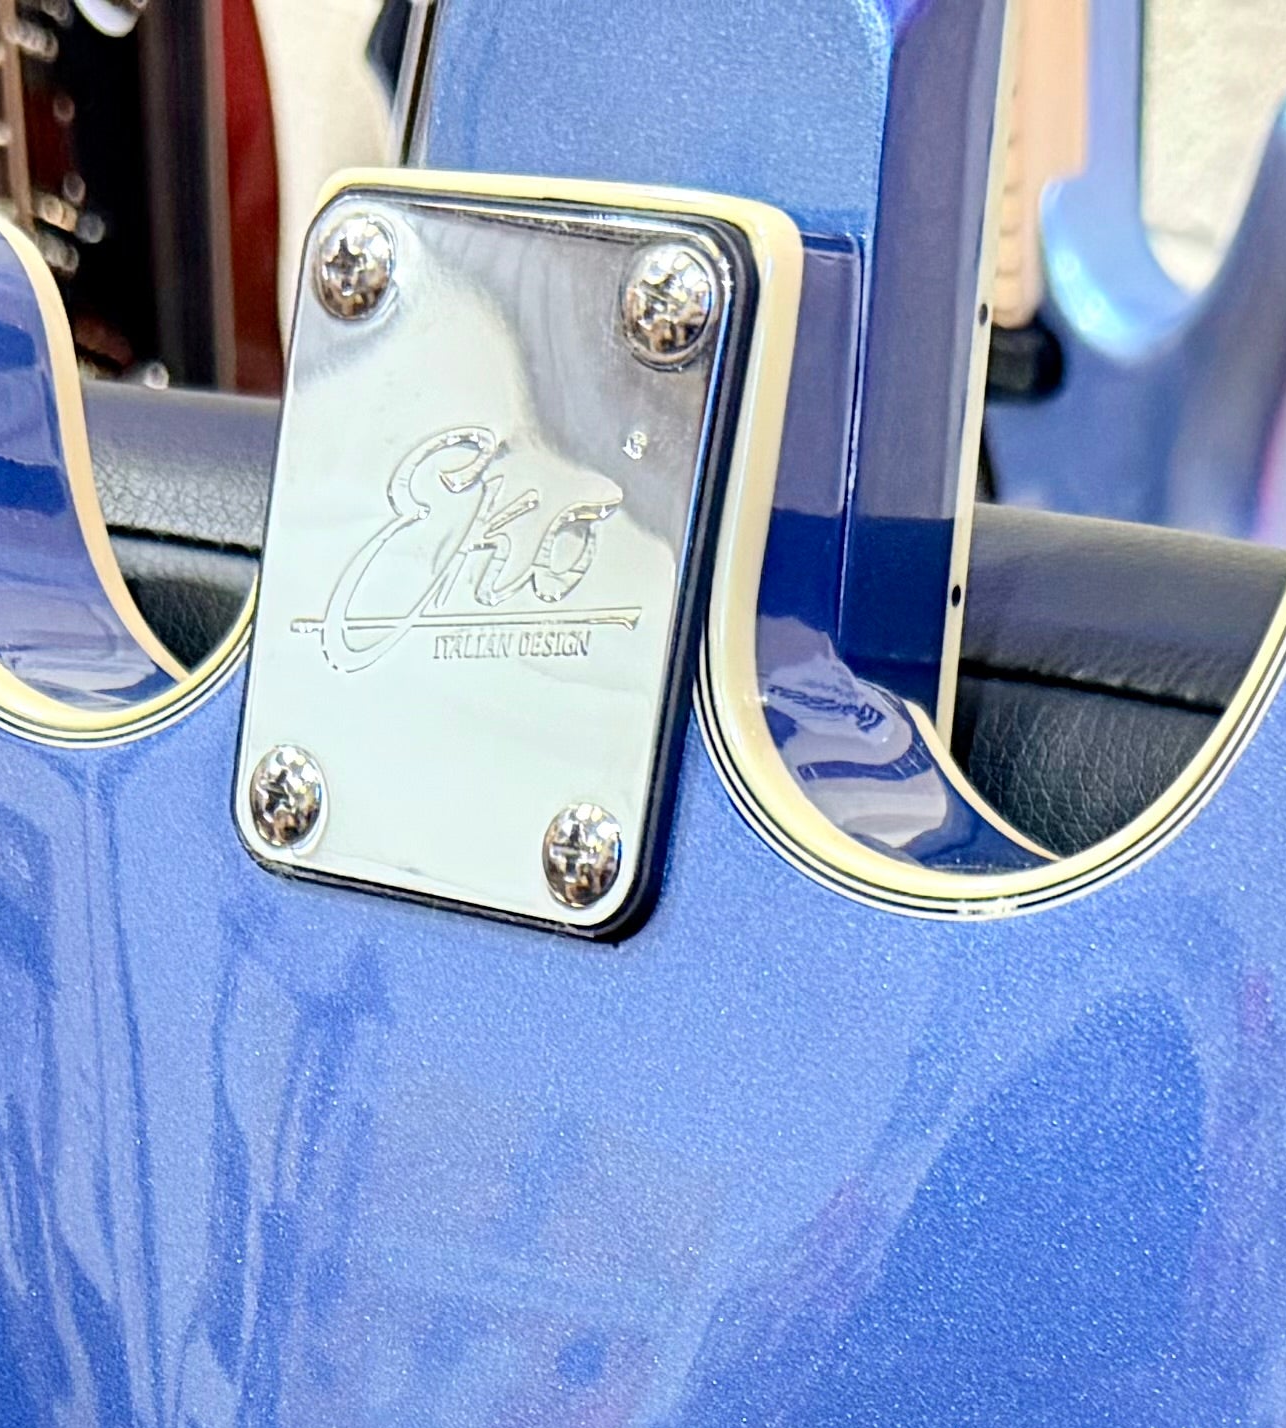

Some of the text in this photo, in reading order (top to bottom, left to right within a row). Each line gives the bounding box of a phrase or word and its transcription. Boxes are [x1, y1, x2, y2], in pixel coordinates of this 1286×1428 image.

[320, 425, 623, 673] Eko
[432, 629, 593, 661] ITALIAN DESIGN
